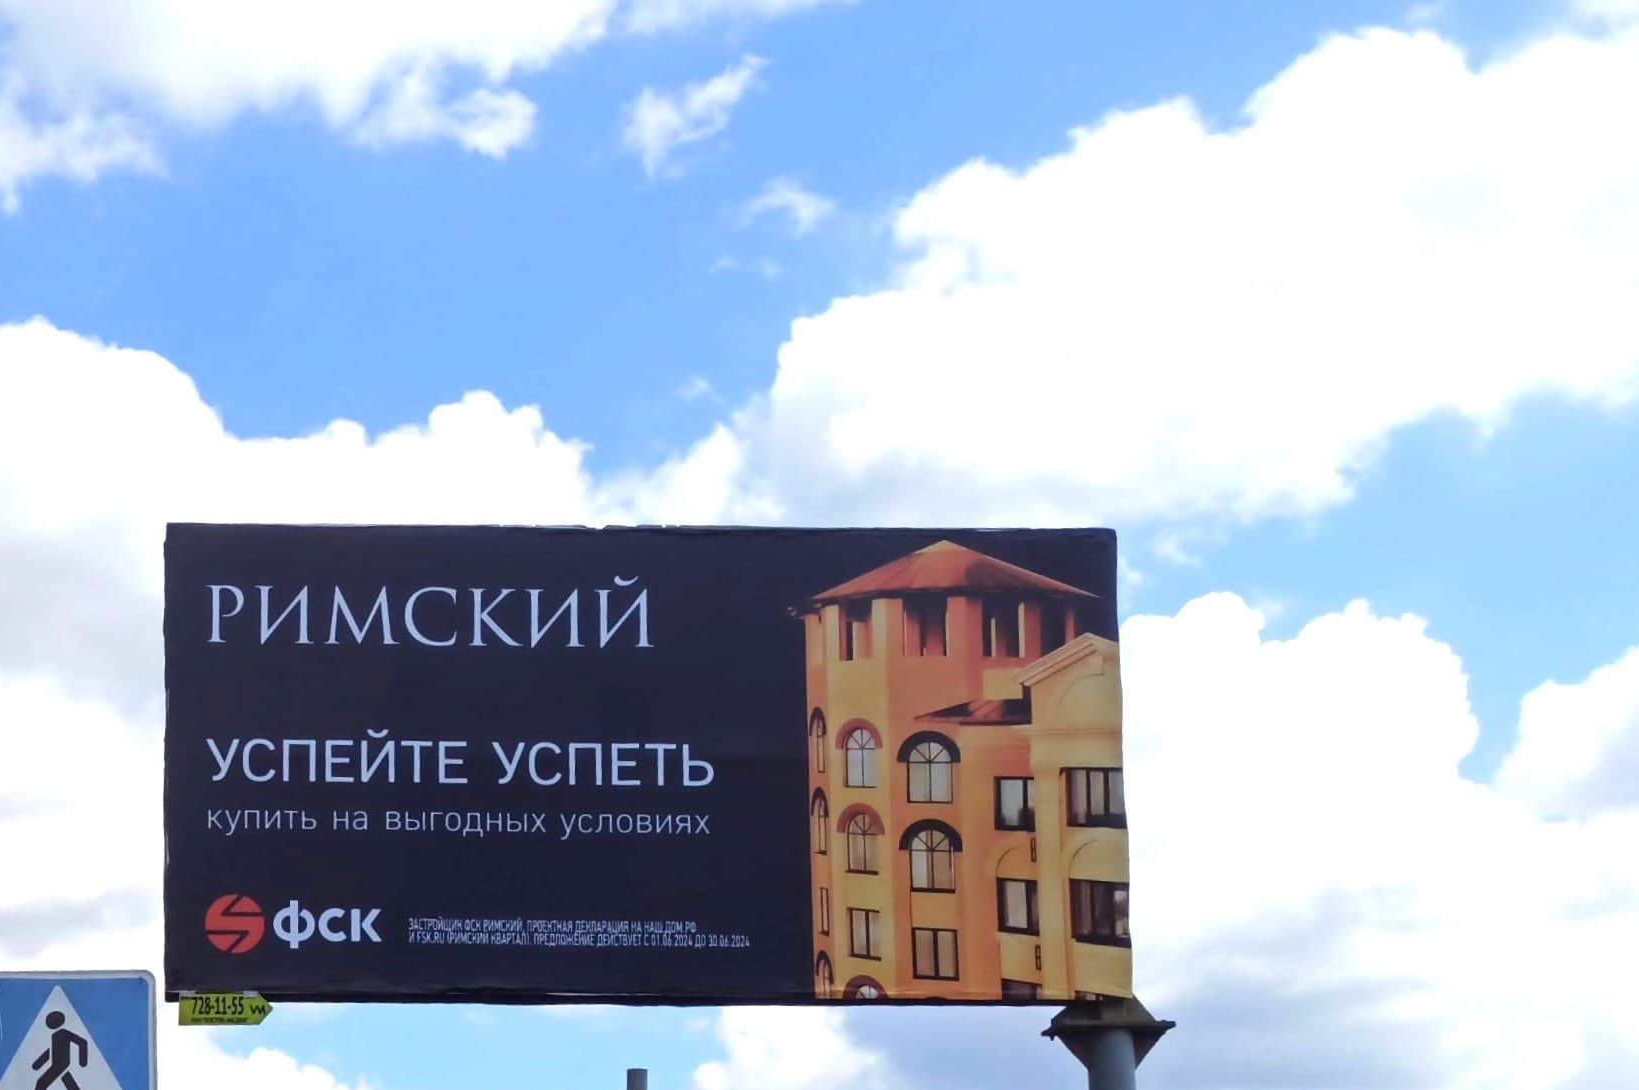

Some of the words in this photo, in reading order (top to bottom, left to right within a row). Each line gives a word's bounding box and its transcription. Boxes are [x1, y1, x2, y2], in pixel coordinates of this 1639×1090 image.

[206, 575, 654, 649] РИМСКИЙ
[206, 728, 468, 785] УСПЕЙТЕ
[492, 741, 715, 787] УСПЕТЬ
[207, 808, 317, 836] купить
[333, 810, 368, 832] на
[385, 811, 546, 838] выгодных
[560, 813, 710, 840] условиях
[273, 900, 382, 949] ФСК
[408, 916, 462, 931] ЗАСТРОЙЩИК
[527, 920, 573, 932] ПРОЕКТНАЯ
[574, 920, 629, 933] ДЕКЛАРАЦИЯ
[631, 921, 642, 932] НА
[534, 933, 595, 946] ПРЕДЛОЖЕНИЕ
[597, 934, 642, 946] ДЕЙСТВУЕТ
[191, 996, 245, 1016] 728-11-55
